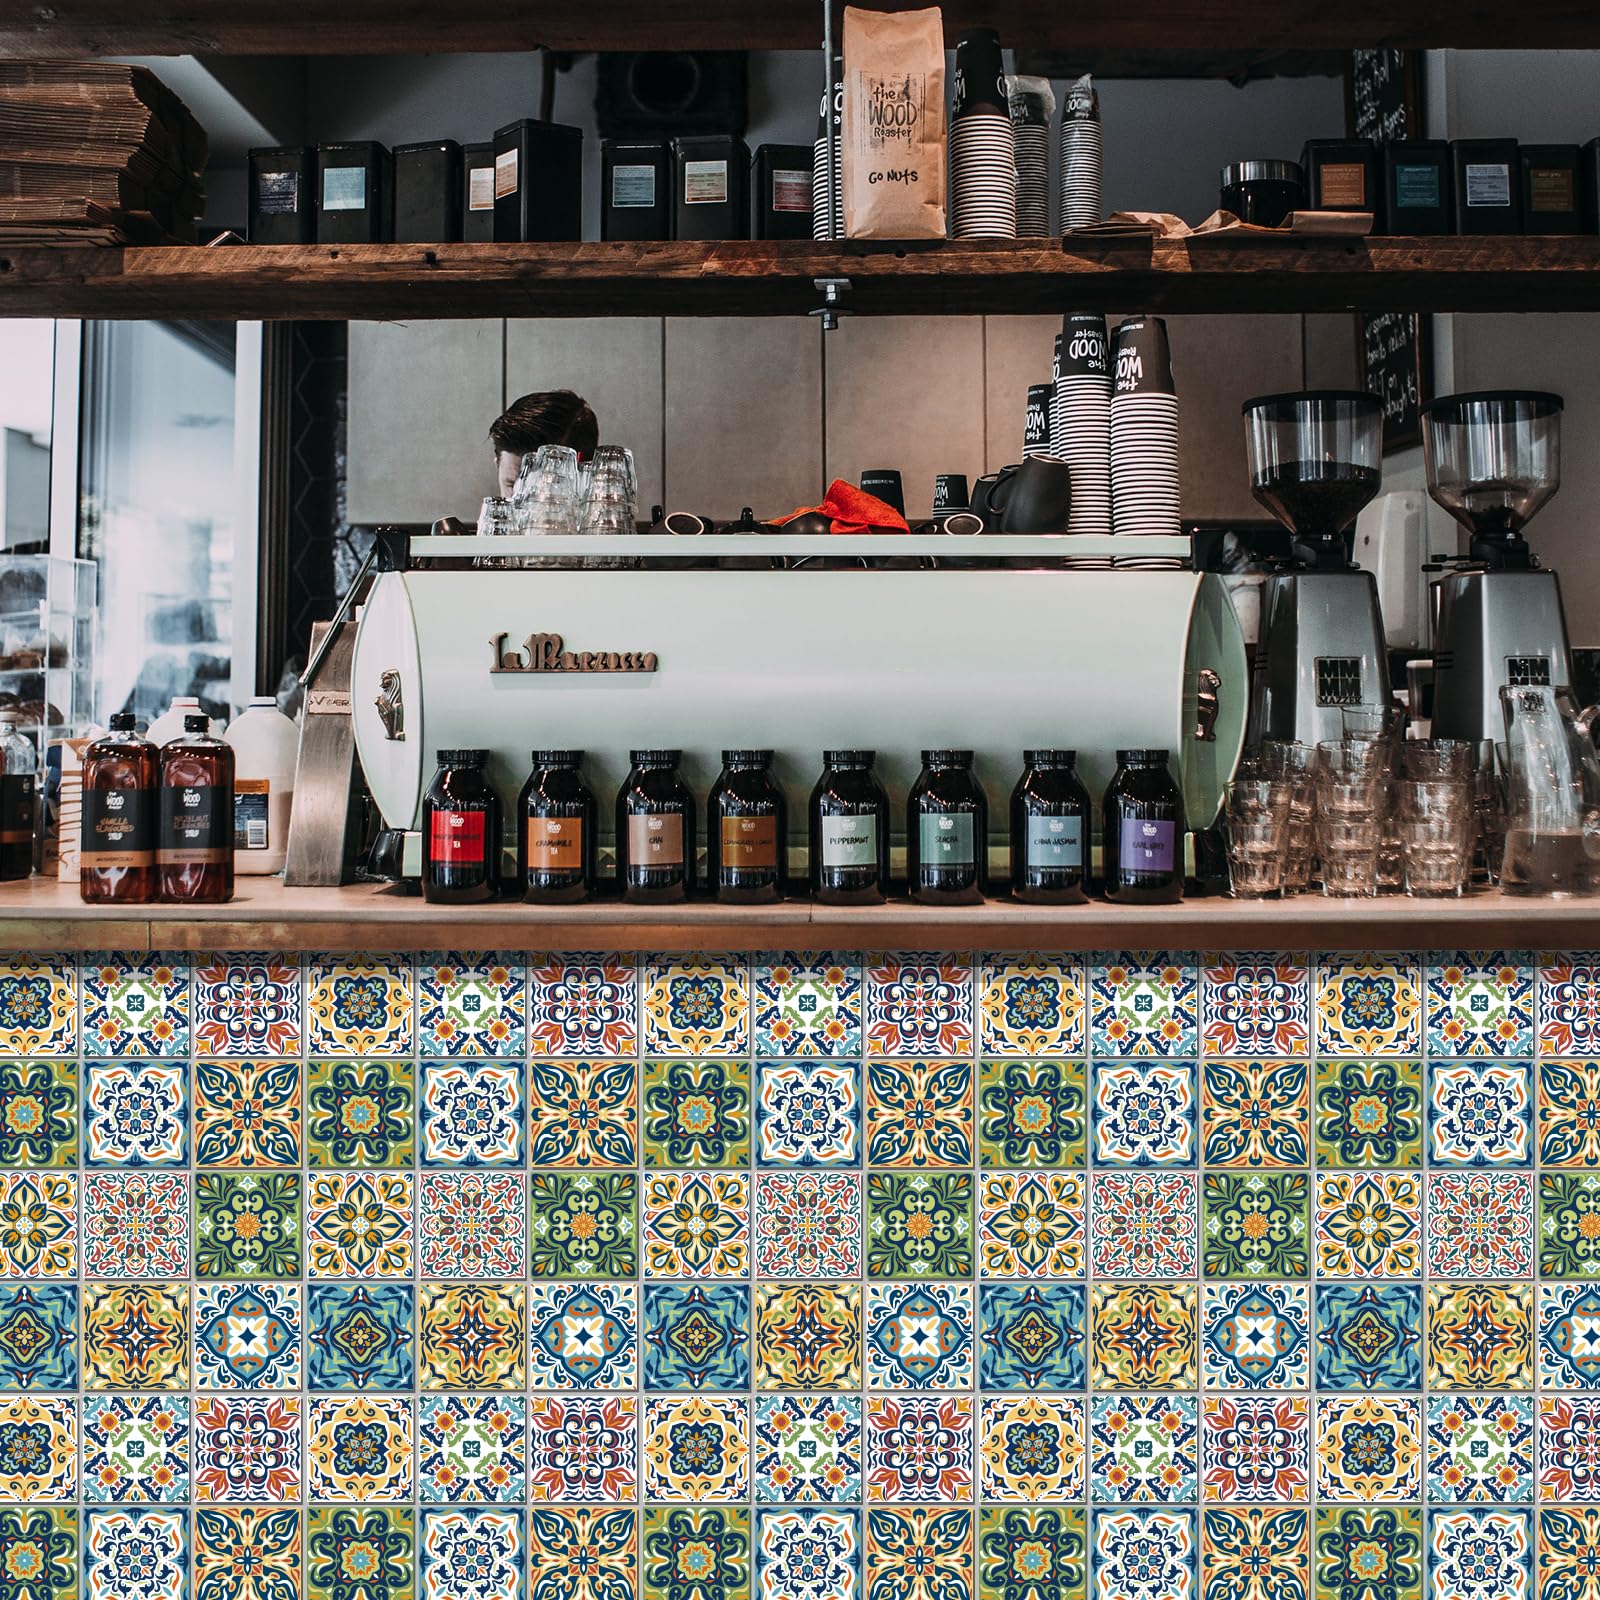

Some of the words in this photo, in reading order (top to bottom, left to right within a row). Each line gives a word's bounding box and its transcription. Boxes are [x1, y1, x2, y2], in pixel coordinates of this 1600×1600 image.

[873, 87, 896, 102] the
[869, 100, 917, 127] WOOD
[874, 127, 912, 140] Roaster
[1074, 328, 1103, 340] Roaster
[1069, 338, 1108, 360] WOOD
[1088, 359, 1107, 371] the
[1117, 376, 1138, 391] the
[1026, 429, 1042, 441] the
[1318, 695, 1362, 705] MAZZER
[106, 796, 125, 806] WOOD
[183, 793, 201, 803] WOOD
[829, 836, 869, 845] PEPPERMINT
[934, 836, 959, 844] SENCHA
[1052, 838, 1077, 846] JASMINE
